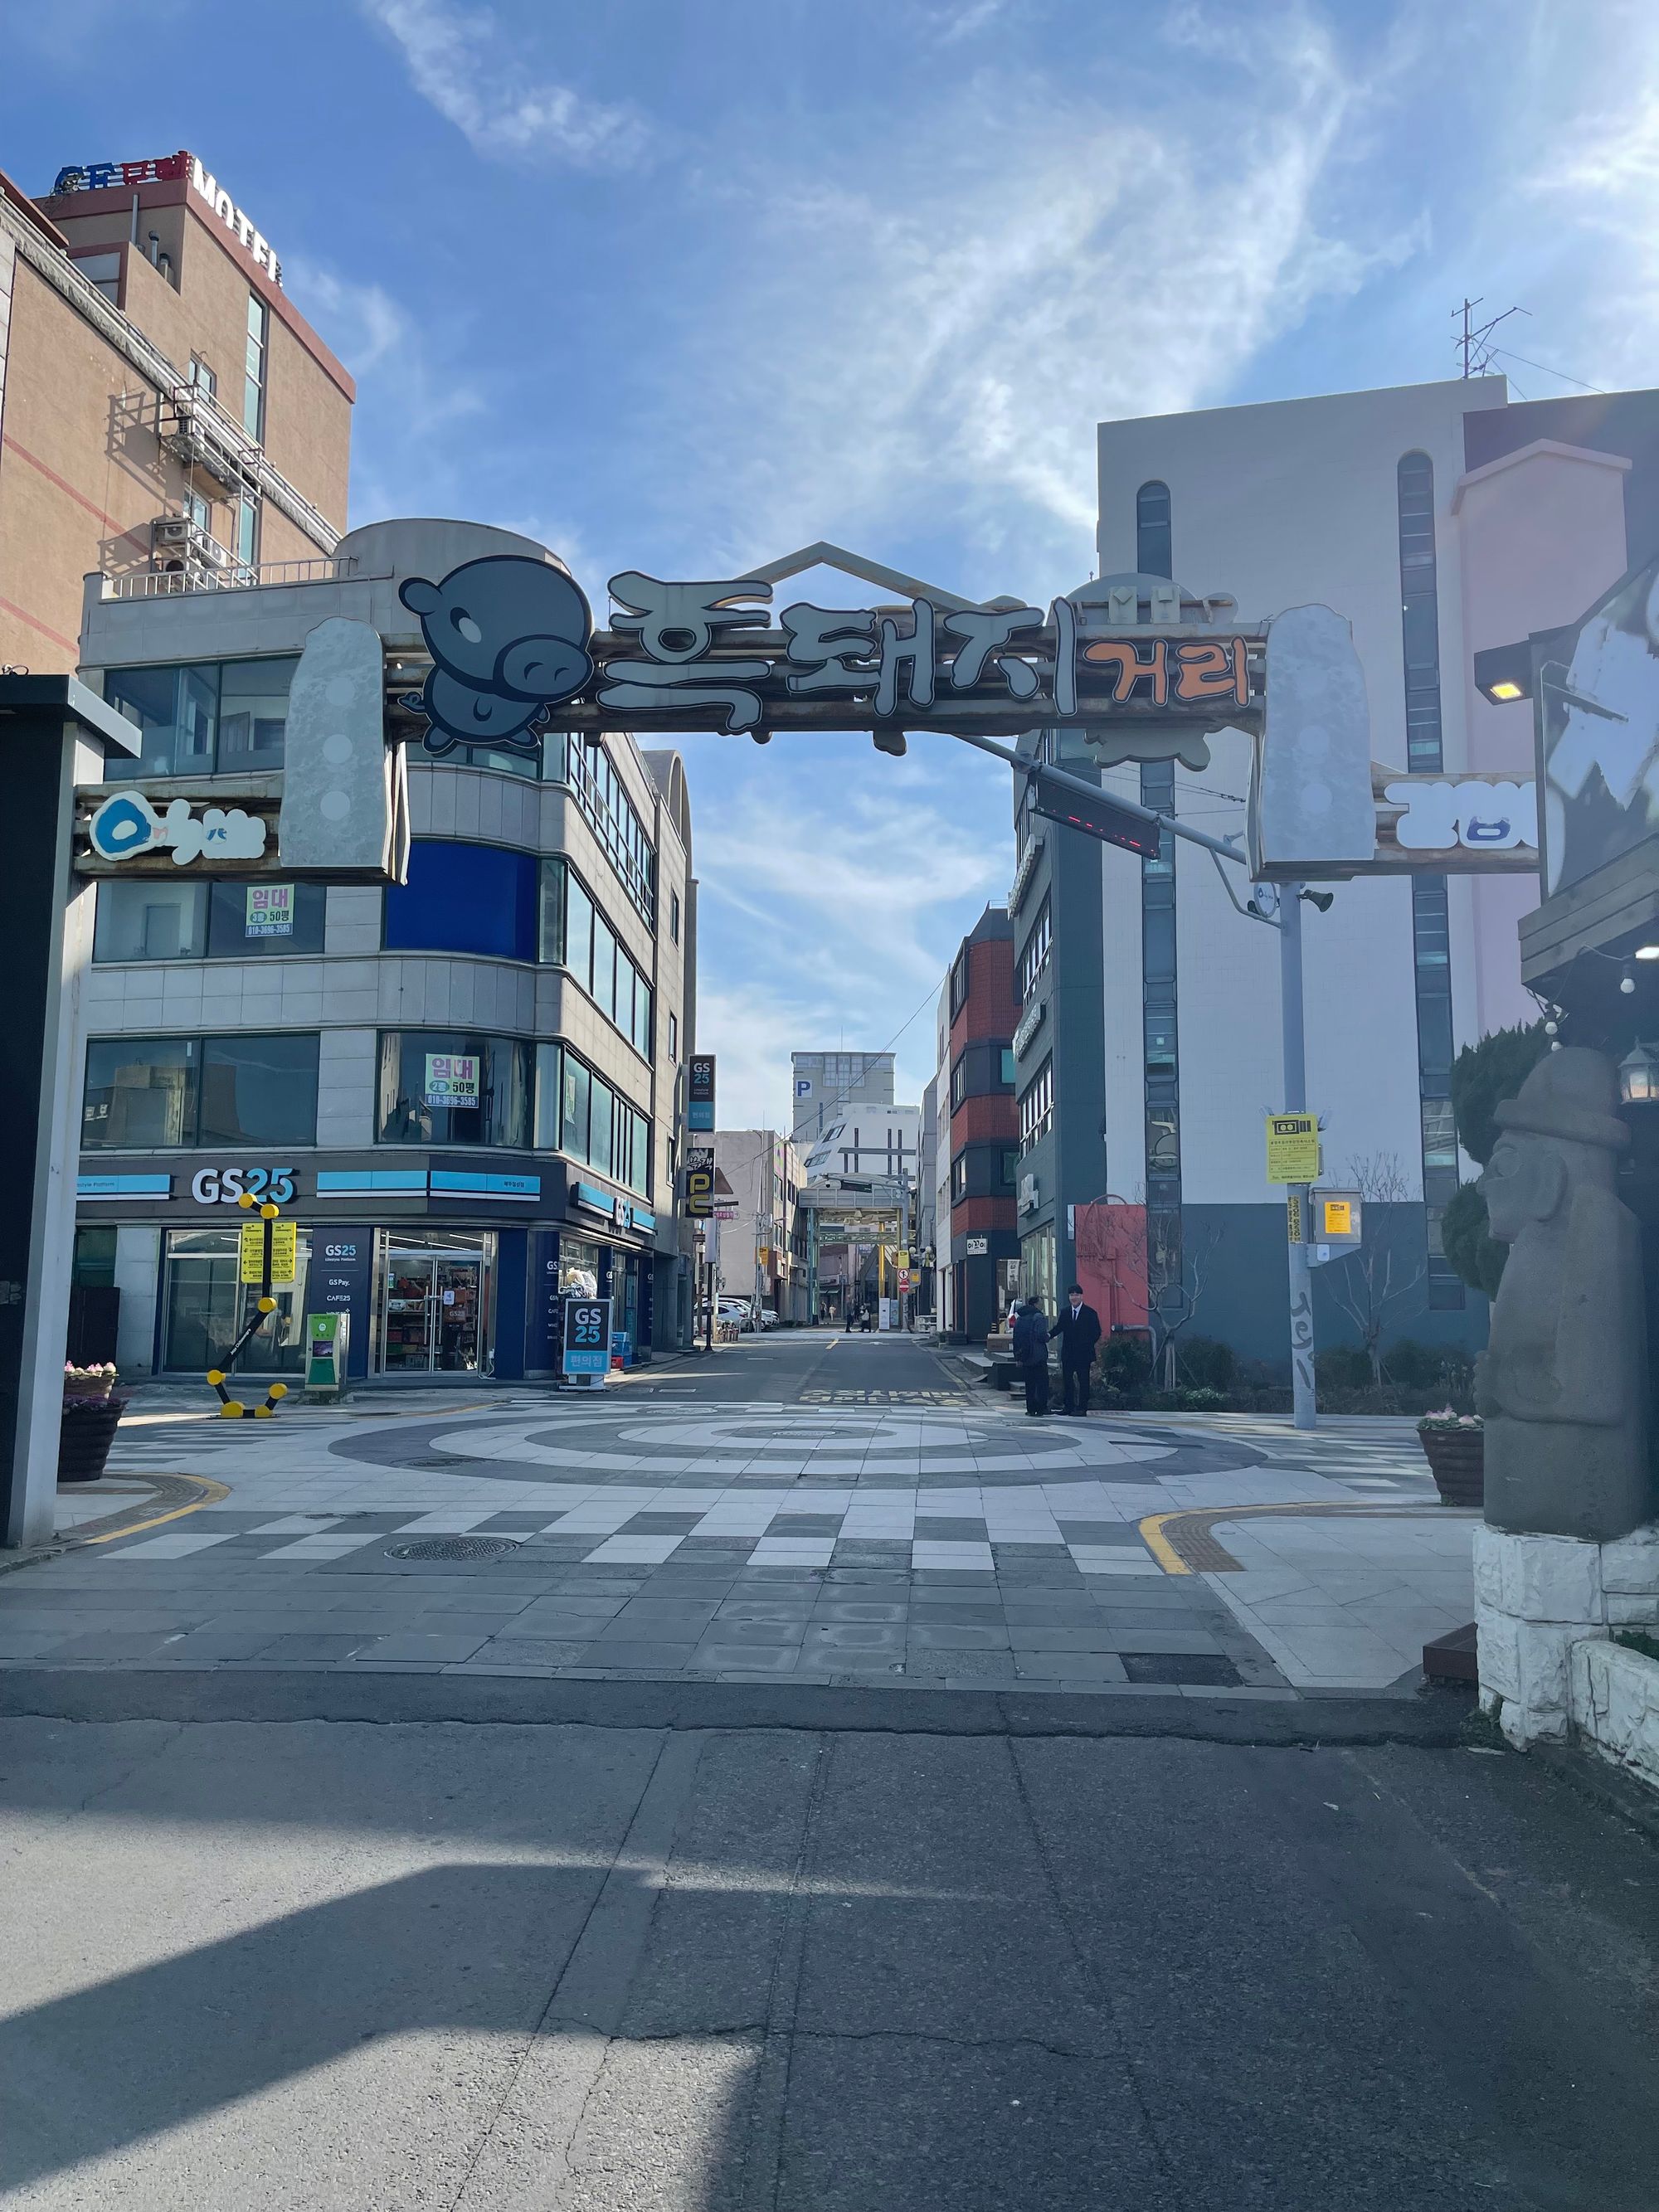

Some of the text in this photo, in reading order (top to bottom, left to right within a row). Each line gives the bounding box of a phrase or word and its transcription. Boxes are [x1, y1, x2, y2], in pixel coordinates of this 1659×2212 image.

[596, 570, 1250, 731] 흑돼지 거리
[252, 888, 288, 909] 임대
[270, 910, 289, 921] 50평
[432, 1057, 473, 1080] 임대
[693, 1062, 710, 1073] GS
[693, 1074, 709, 1084] 25
[452, 1082, 474, 1094] 50평
[798, 1082, 810, 1096] P
[688, 1155, 713, 1170] 블랙
[192, 1169, 294, 1203] GS25
[325, 1245, 356, 1256] GS25
[547, 1261, 558, 1270] GS
[575, 1308, 601, 1325] GS
[575, 1325, 600, 1343] 25
[570, 1355, 602, 1368] 편의점
